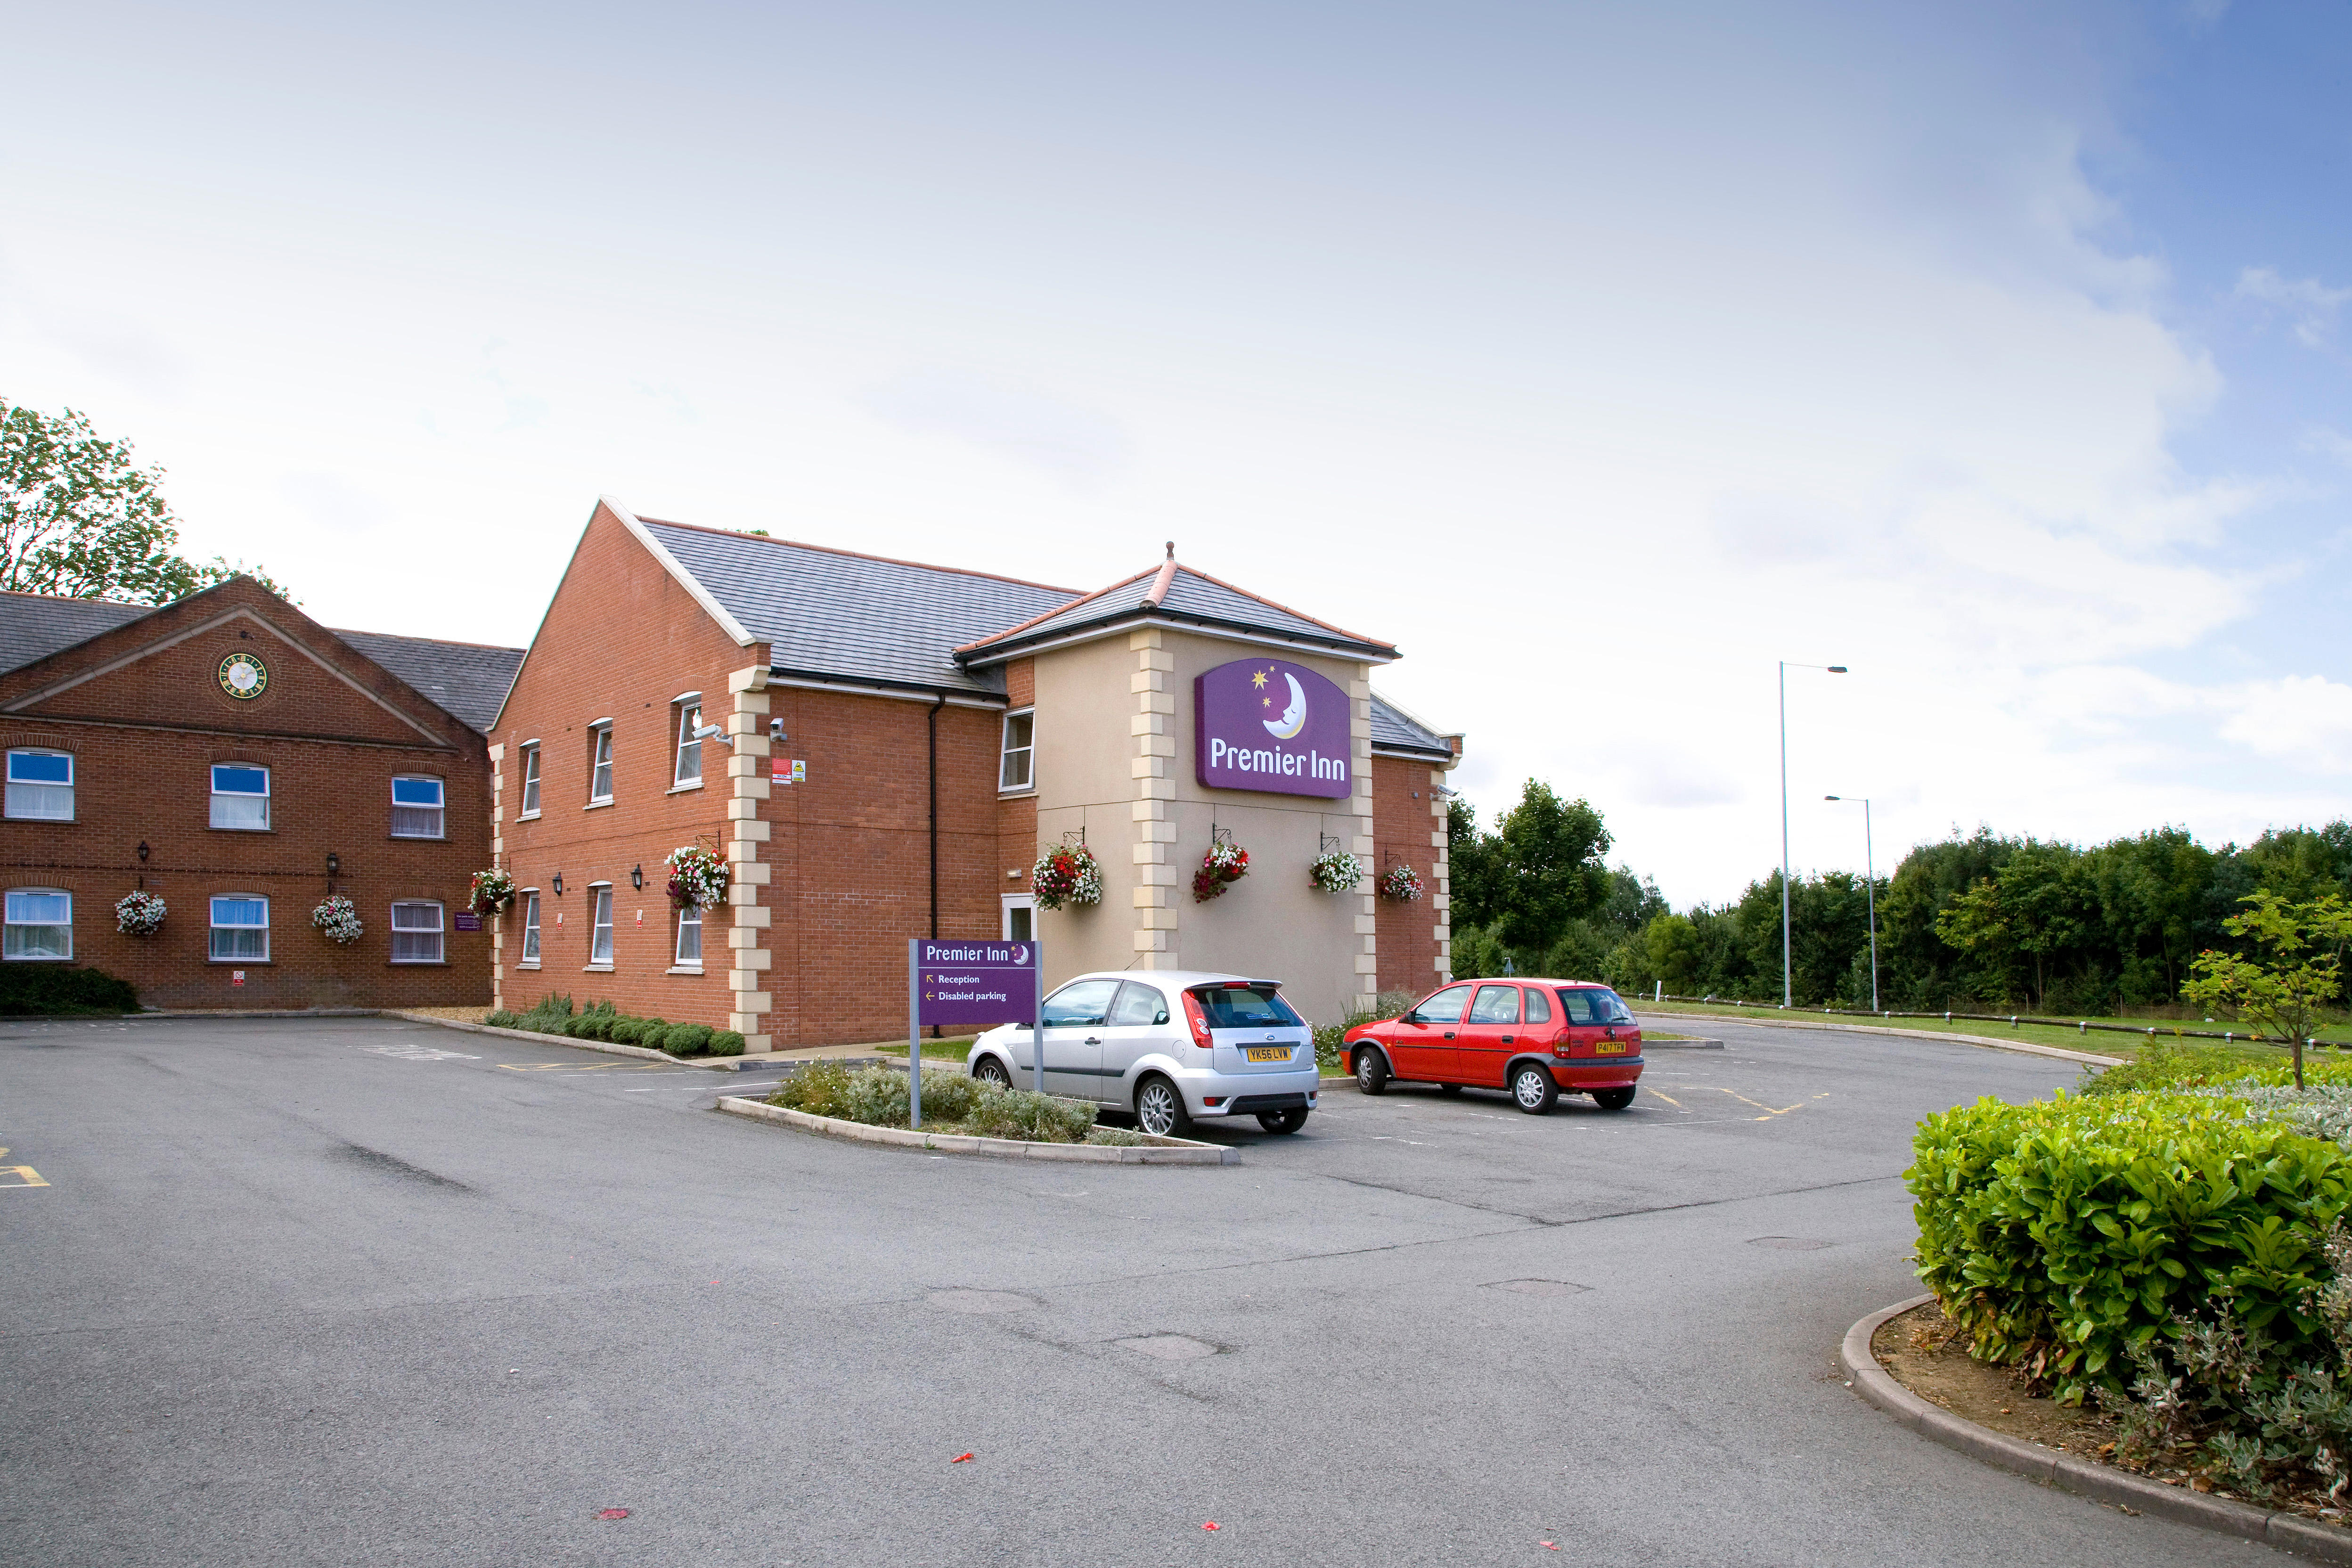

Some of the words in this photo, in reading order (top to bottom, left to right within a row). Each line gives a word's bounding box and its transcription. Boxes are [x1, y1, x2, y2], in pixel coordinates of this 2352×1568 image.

[1211, 738, 1307, 776] Premier
[1311, 750, 1345, 781] Inn
[926, 945, 983, 961] Premier
[987, 946, 1008, 961] Inn
[939, 975, 980, 986] Reception
[939, 992, 974, 1000] Disabled
[976, 991, 1006, 1002] parking
[1250, 1049, 1272, 1060] YK56
